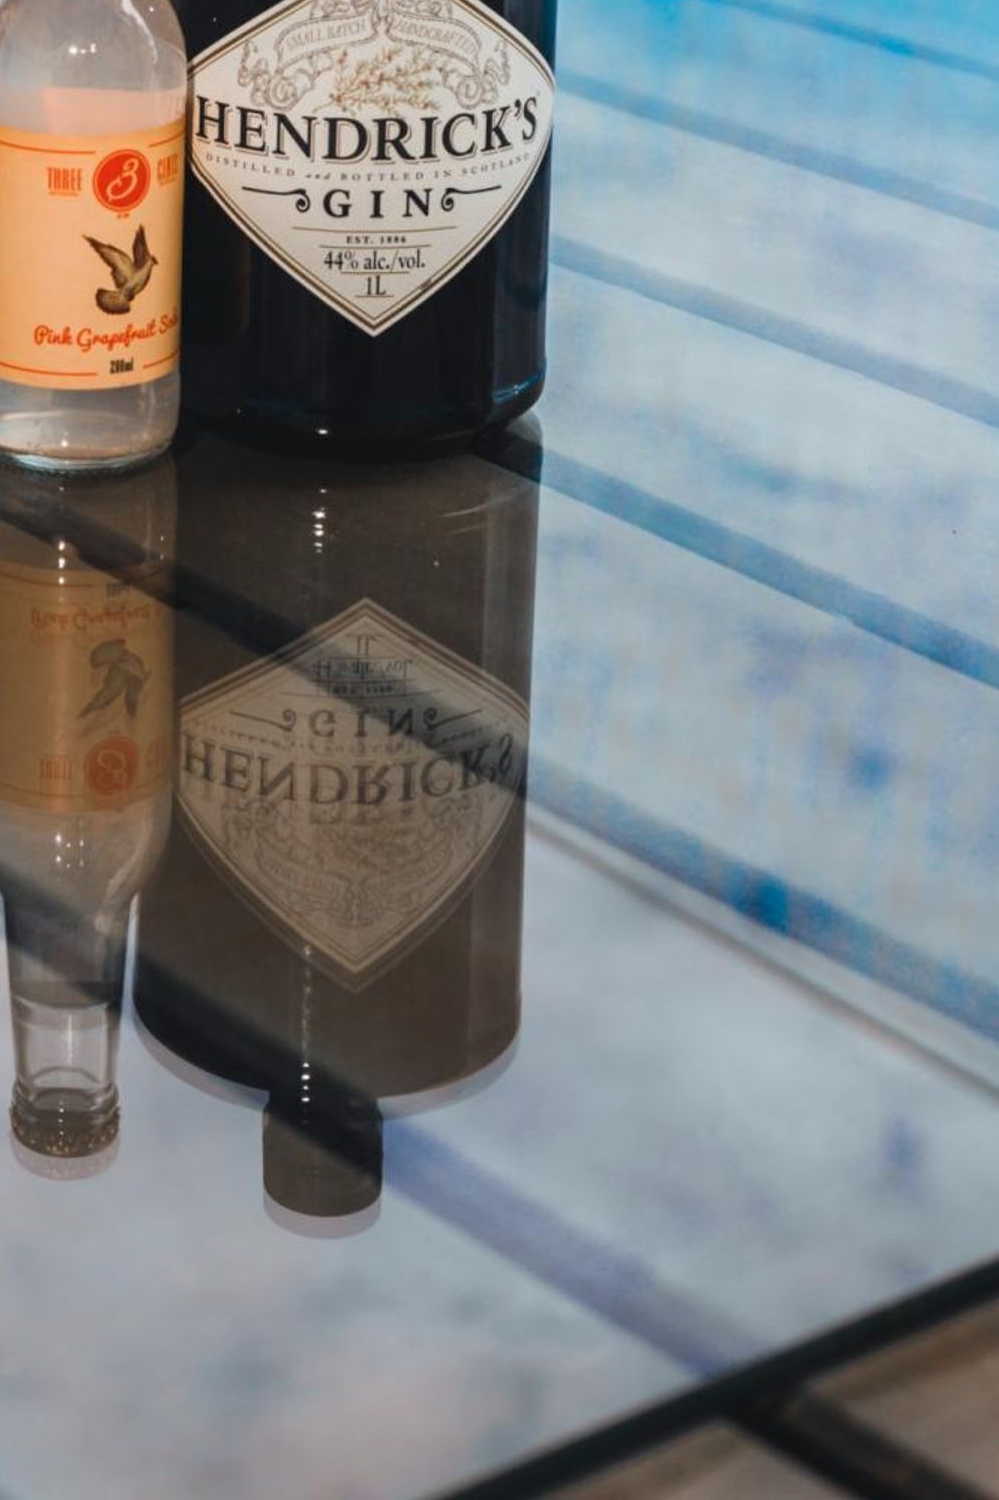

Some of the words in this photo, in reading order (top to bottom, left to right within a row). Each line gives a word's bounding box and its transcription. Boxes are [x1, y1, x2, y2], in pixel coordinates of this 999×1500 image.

[195, 95, 539, 163] HENDRICK'S
[46, 166, 82, 192] THREE
[205, 152, 296, 177] DISTILLED
[340, 172, 424, 182] BOTTLED
[434, 169, 452, 179] IN
[322, 187, 434, 219] GIN
[346, 235, 374, 245] EST.
[323, 250, 360, 270] 44%
[363, 247, 426, 272] alc./vol.
[366, 275, 387, 296] 1L
[33, 324, 73, 345] Pink
[76, 319, 157, 352] Grapefruit
